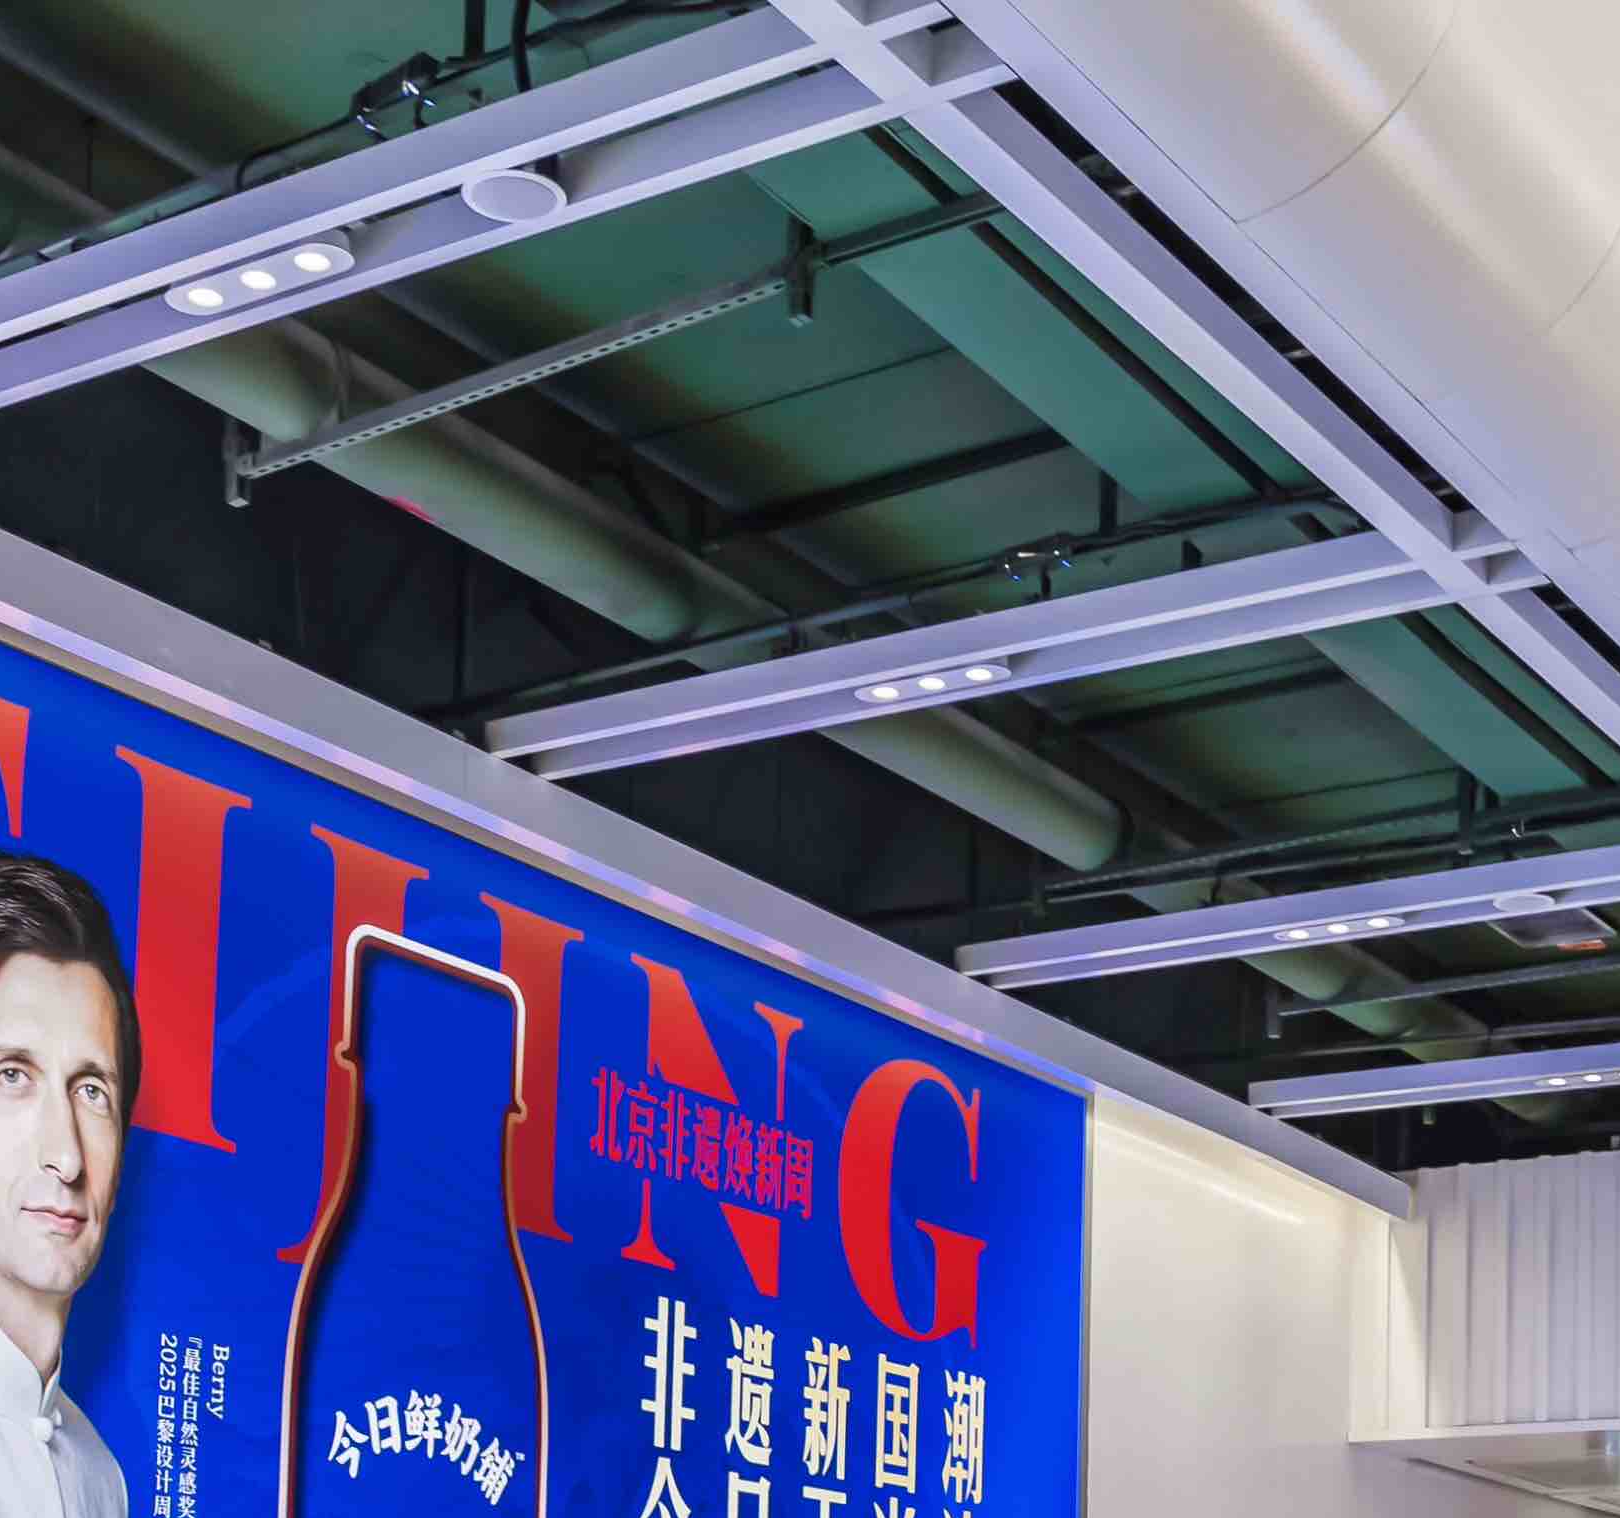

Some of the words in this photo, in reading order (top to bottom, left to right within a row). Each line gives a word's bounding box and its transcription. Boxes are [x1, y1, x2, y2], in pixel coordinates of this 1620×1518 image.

[590, 1066, 815, 1220] 北京非遗焕新周
[206, 1342, 230, 1420] Berny
[327, 1388, 516, 1506] 今日鲜奶铺
[643, 1294, 986, 1505] 非遗新国潮
